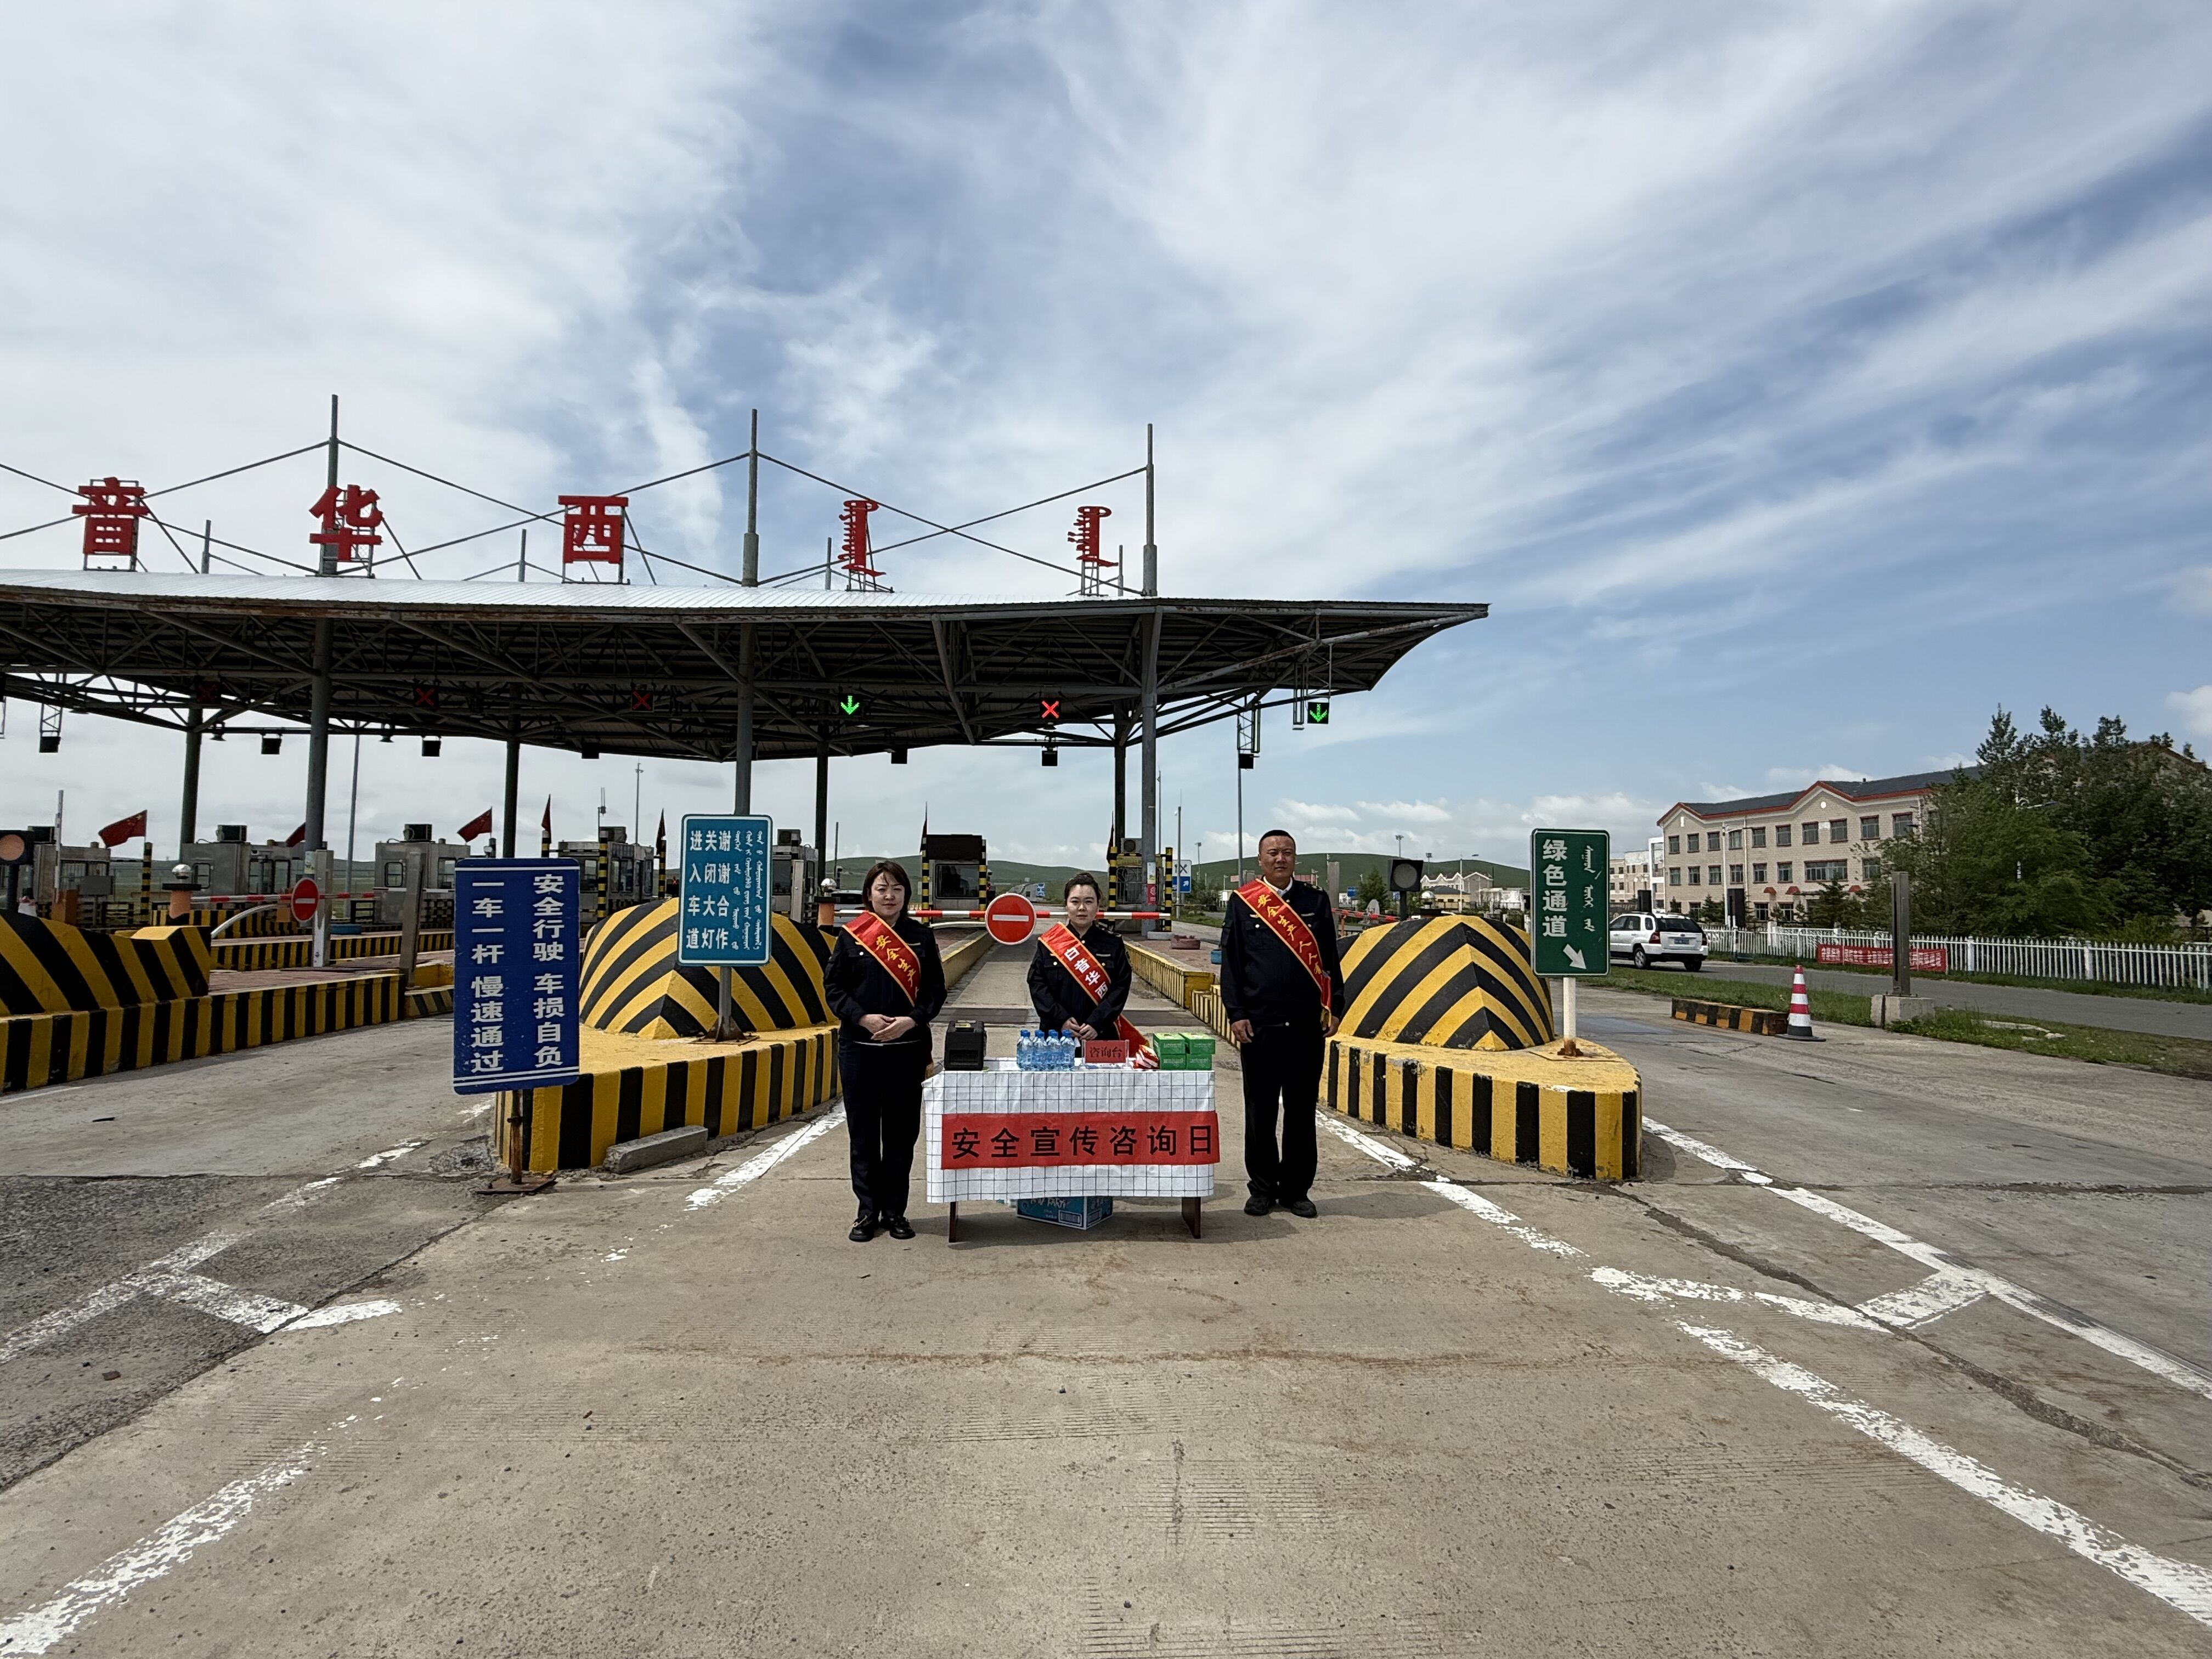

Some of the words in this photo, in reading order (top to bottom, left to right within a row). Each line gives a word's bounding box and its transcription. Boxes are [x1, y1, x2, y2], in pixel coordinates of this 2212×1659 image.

[471, 882, 505, 964] 一车一杆
[532, 873, 565, 962] 安全行驶
[686, 830, 703, 950] 进入车道
[701, 830, 718, 950] 关闭大灯
[715, 830, 731, 950] 谢谢合作
[1542, 839, 1568, 937] 绿色通道
[533, 973, 565, 1068] 车损自负
[1064, 946, 1109, 1000] 白音华西
[470, 975, 505, 1074] 慢速通过
[1090, 1046, 1122, 1058] 咨询台
[951, 1125, 1211, 1159] 安全宣传咨询日
